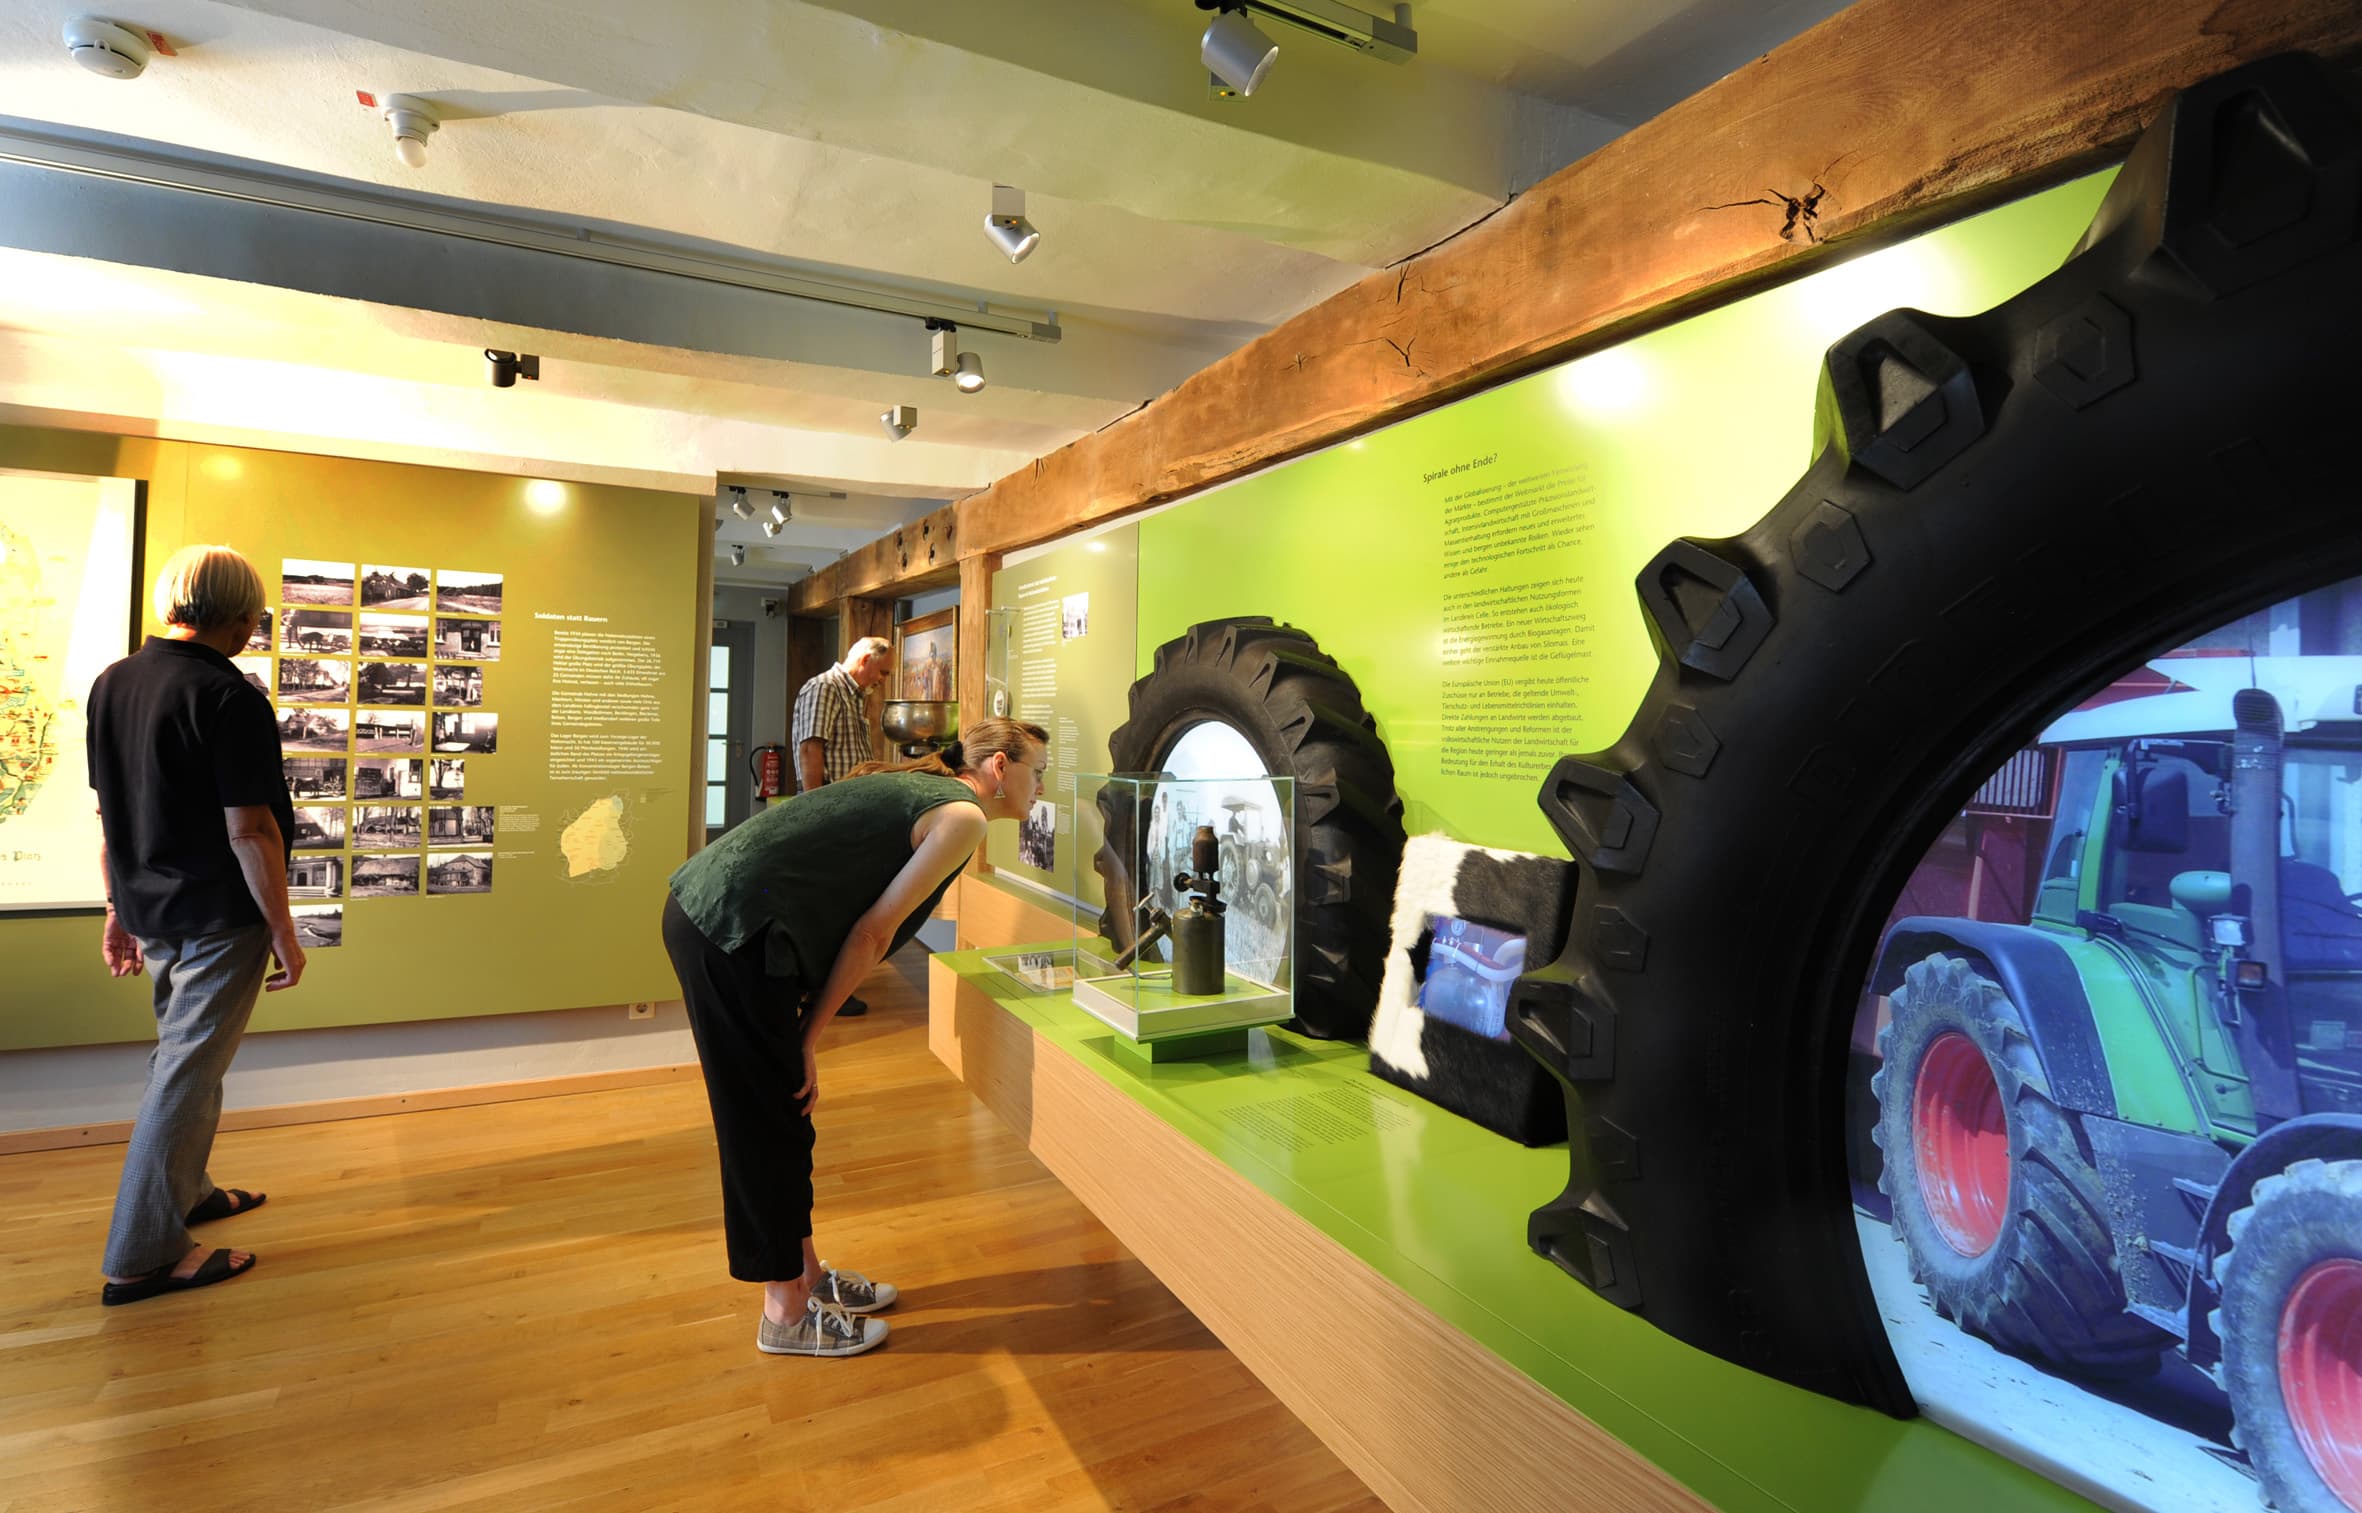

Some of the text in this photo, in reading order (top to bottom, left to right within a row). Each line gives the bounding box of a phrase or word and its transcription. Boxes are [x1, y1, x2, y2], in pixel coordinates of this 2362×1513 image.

[1423, 453, 1498, 484] Spirale ohne Ende?
[534, 612, 565, 621] Soldaten
[584, 615, 608, 623] Bauern
